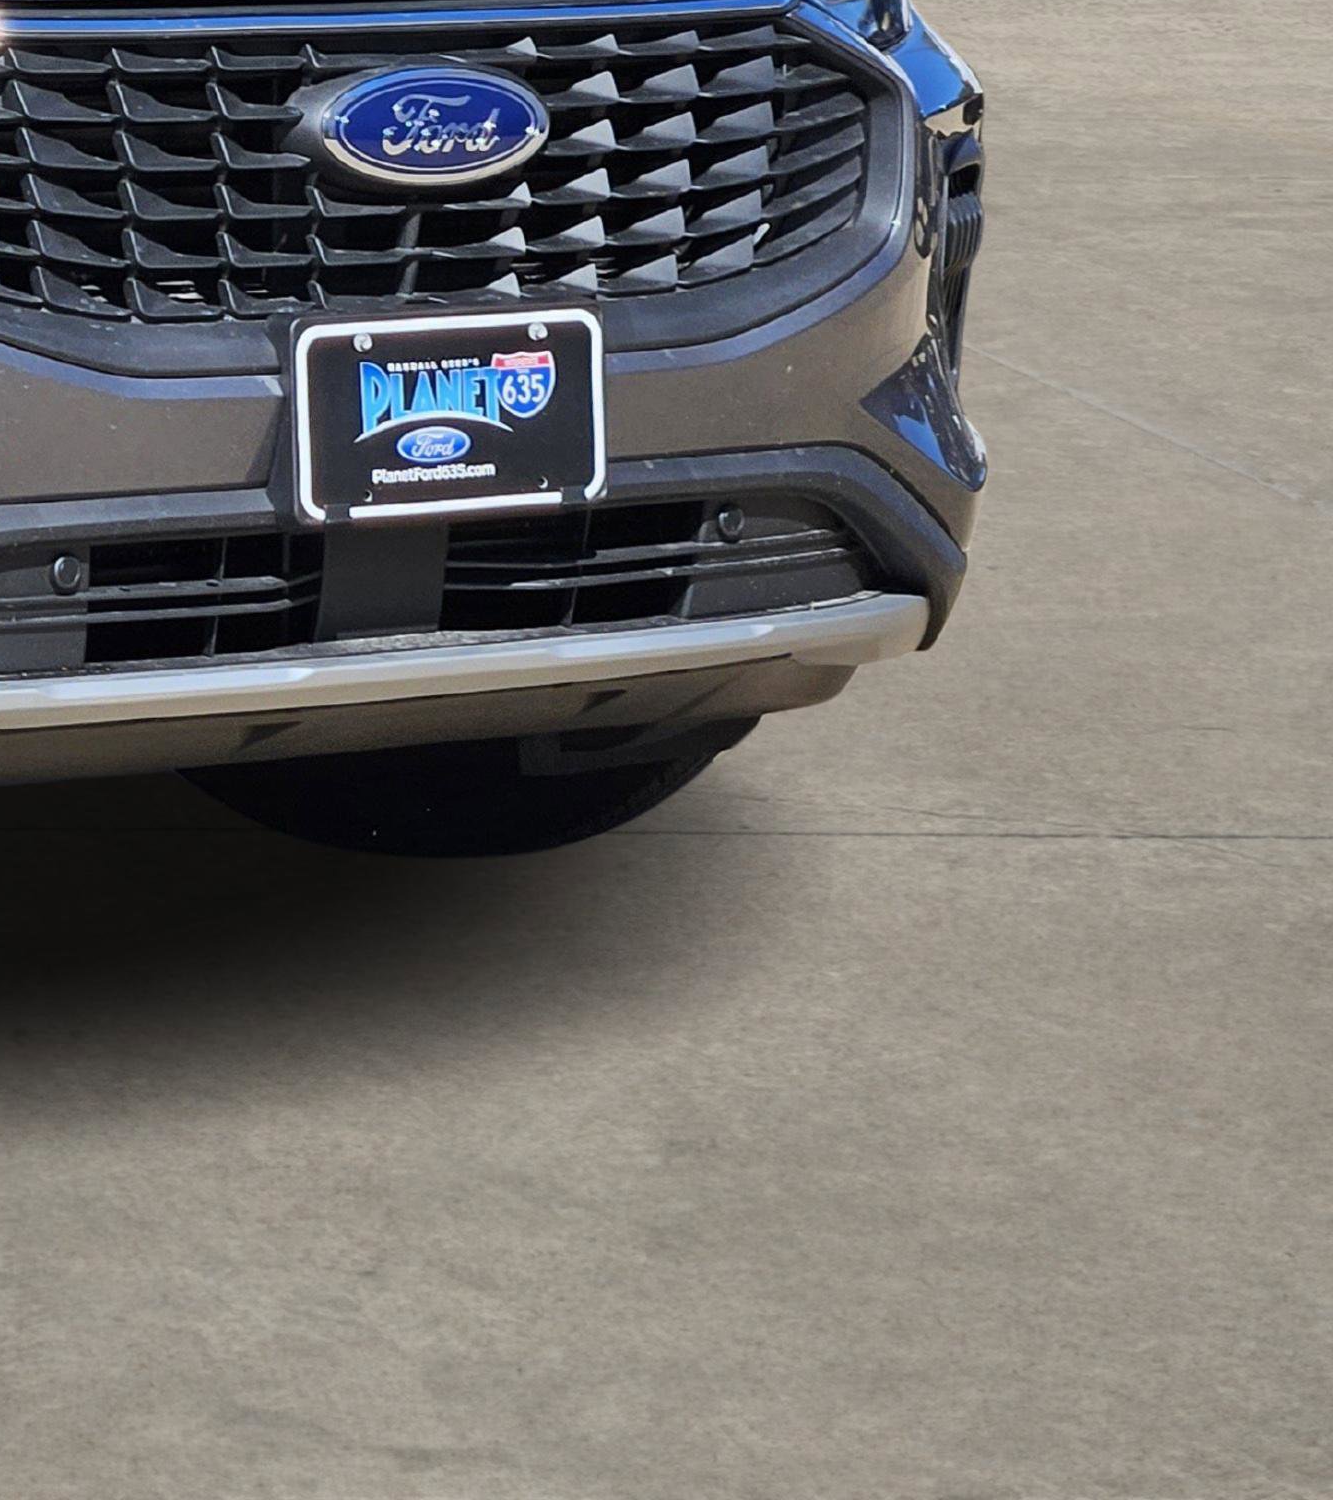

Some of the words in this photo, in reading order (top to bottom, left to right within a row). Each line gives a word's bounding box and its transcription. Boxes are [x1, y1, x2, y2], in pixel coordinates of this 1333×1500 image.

[383, 94, 501, 156] Ford
[360, 362, 501, 433] PLANET
[502, 374, 545, 404] 635
[411, 433, 455, 457] Ford
